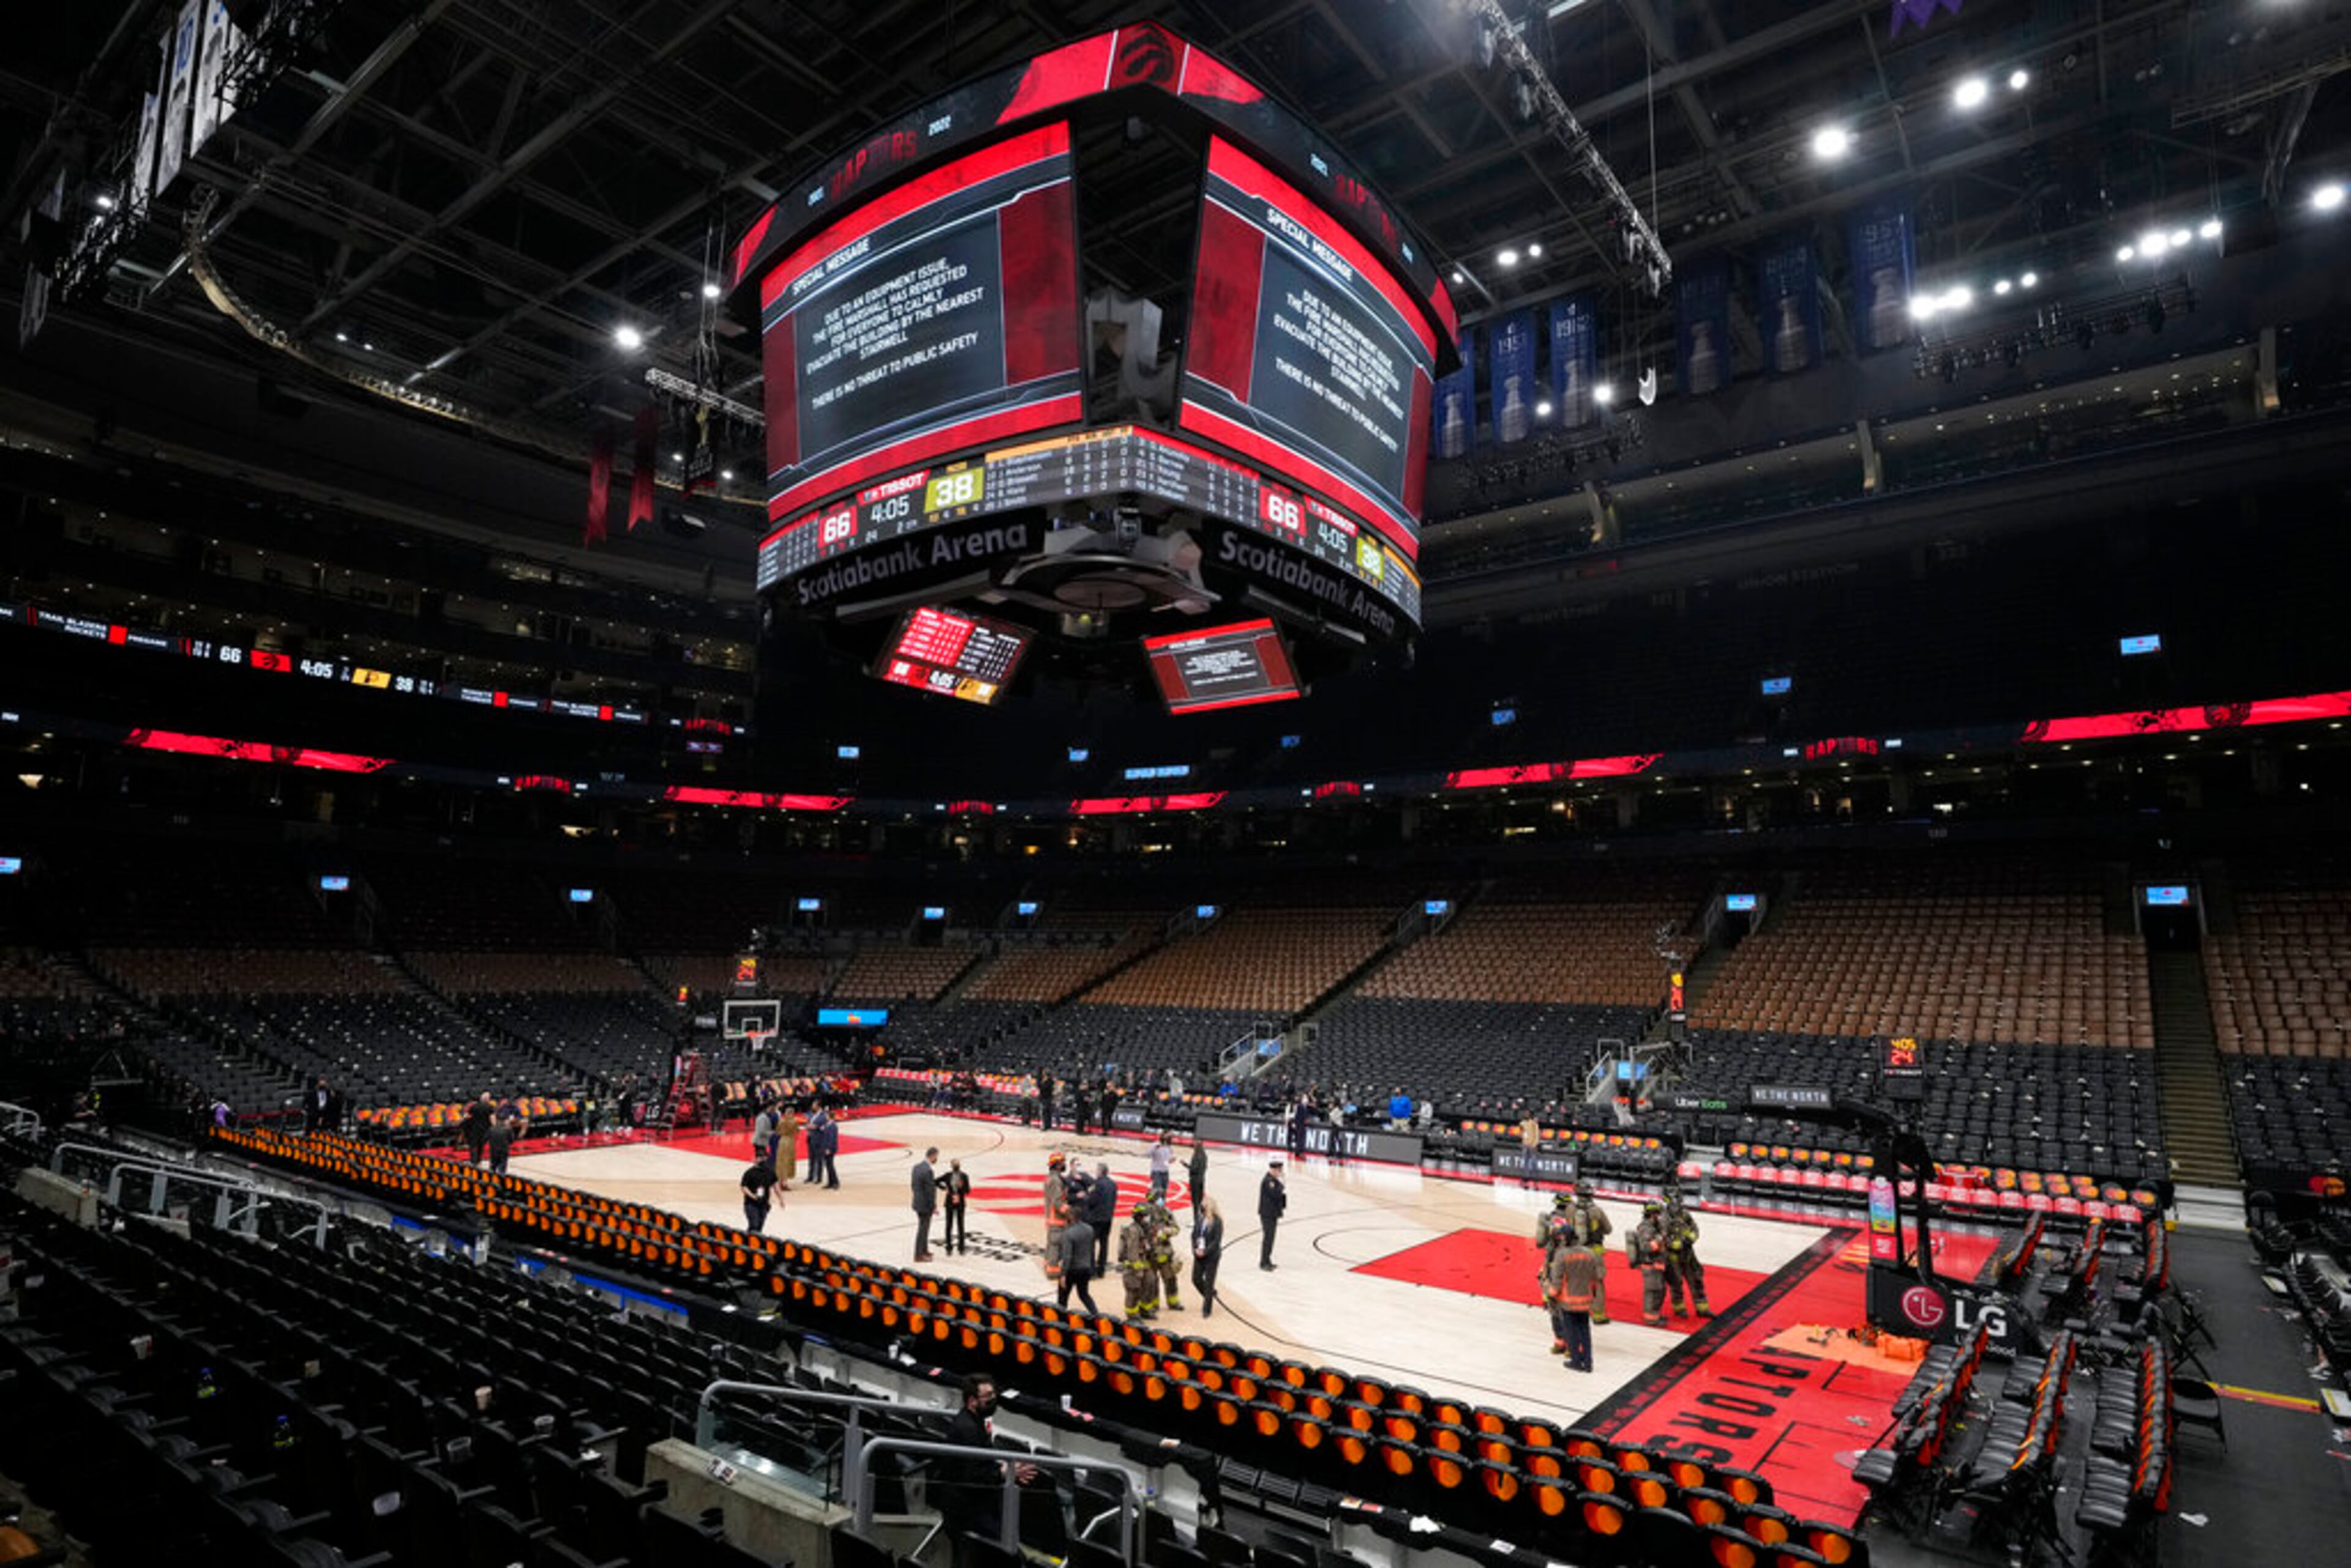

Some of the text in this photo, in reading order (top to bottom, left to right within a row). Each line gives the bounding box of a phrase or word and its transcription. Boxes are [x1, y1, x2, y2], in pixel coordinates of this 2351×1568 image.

[1267, 208, 1309, 249] SPECIAL
[1313, 239, 1353, 282] MESSAGE
[792, 238, 870, 296] SPECIAL MESSAGE
[842, 302, 853, 315] TO
[853, 294, 864, 309] AN
[864, 270, 917, 306] EQUIPMENT
[845, 301, 887, 329] MARSHALL
[890, 289, 907, 304] HAS
[909, 264, 967, 296] REQUESTED
[847, 310, 890, 340] EVERYONE
[892, 304, 903, 317] TO
[904, 288, 945, 312] CALMLY
[858, 320, 900, 348] BUILDING
[901, 315, 914, 329] BY
[916, 306, 933, 321] THE
[936, 287, 984, 315] NEAREST
[860, 331, 909, 361] STAIRWELL
[812, 331, 979, 410] THERE IS NO THREAT TO PUBLIC SAFETY
[880, 472, 925, 497] TISSOT
[936, 473, 973, 507] 38
[824, 511, 851, 544] 66
[871, 494, 910, 523] 4:05
[1269, 494, 1299, 530] 66
[1318, 522, 1349, 554] 4:05
[798, 541, 923, 606] Scotiabank
[931, 522, 1029, 565] Arena
[1220, 530, 1349, 608] Scotiabank
[1351, 589, 1395, 634] Arena
[38, 610, 108, 632] TRAIL BLAZERS
[64, 625, 107, 640] ROCKETS
[219, 645, 242, 664] 66
[300, 659, 334, 679] 4:05
[395, 675, 414, 693] 38
[1675, 1097, 1727, 1110] Uber Eats
[1241, 1121, 1259, 1142] WE
[1499, 1155, 1512, 1167] WE
[1536, 1159, 1573, 1174] NORTH
[1955, 1299, 2008, 1338] LG
